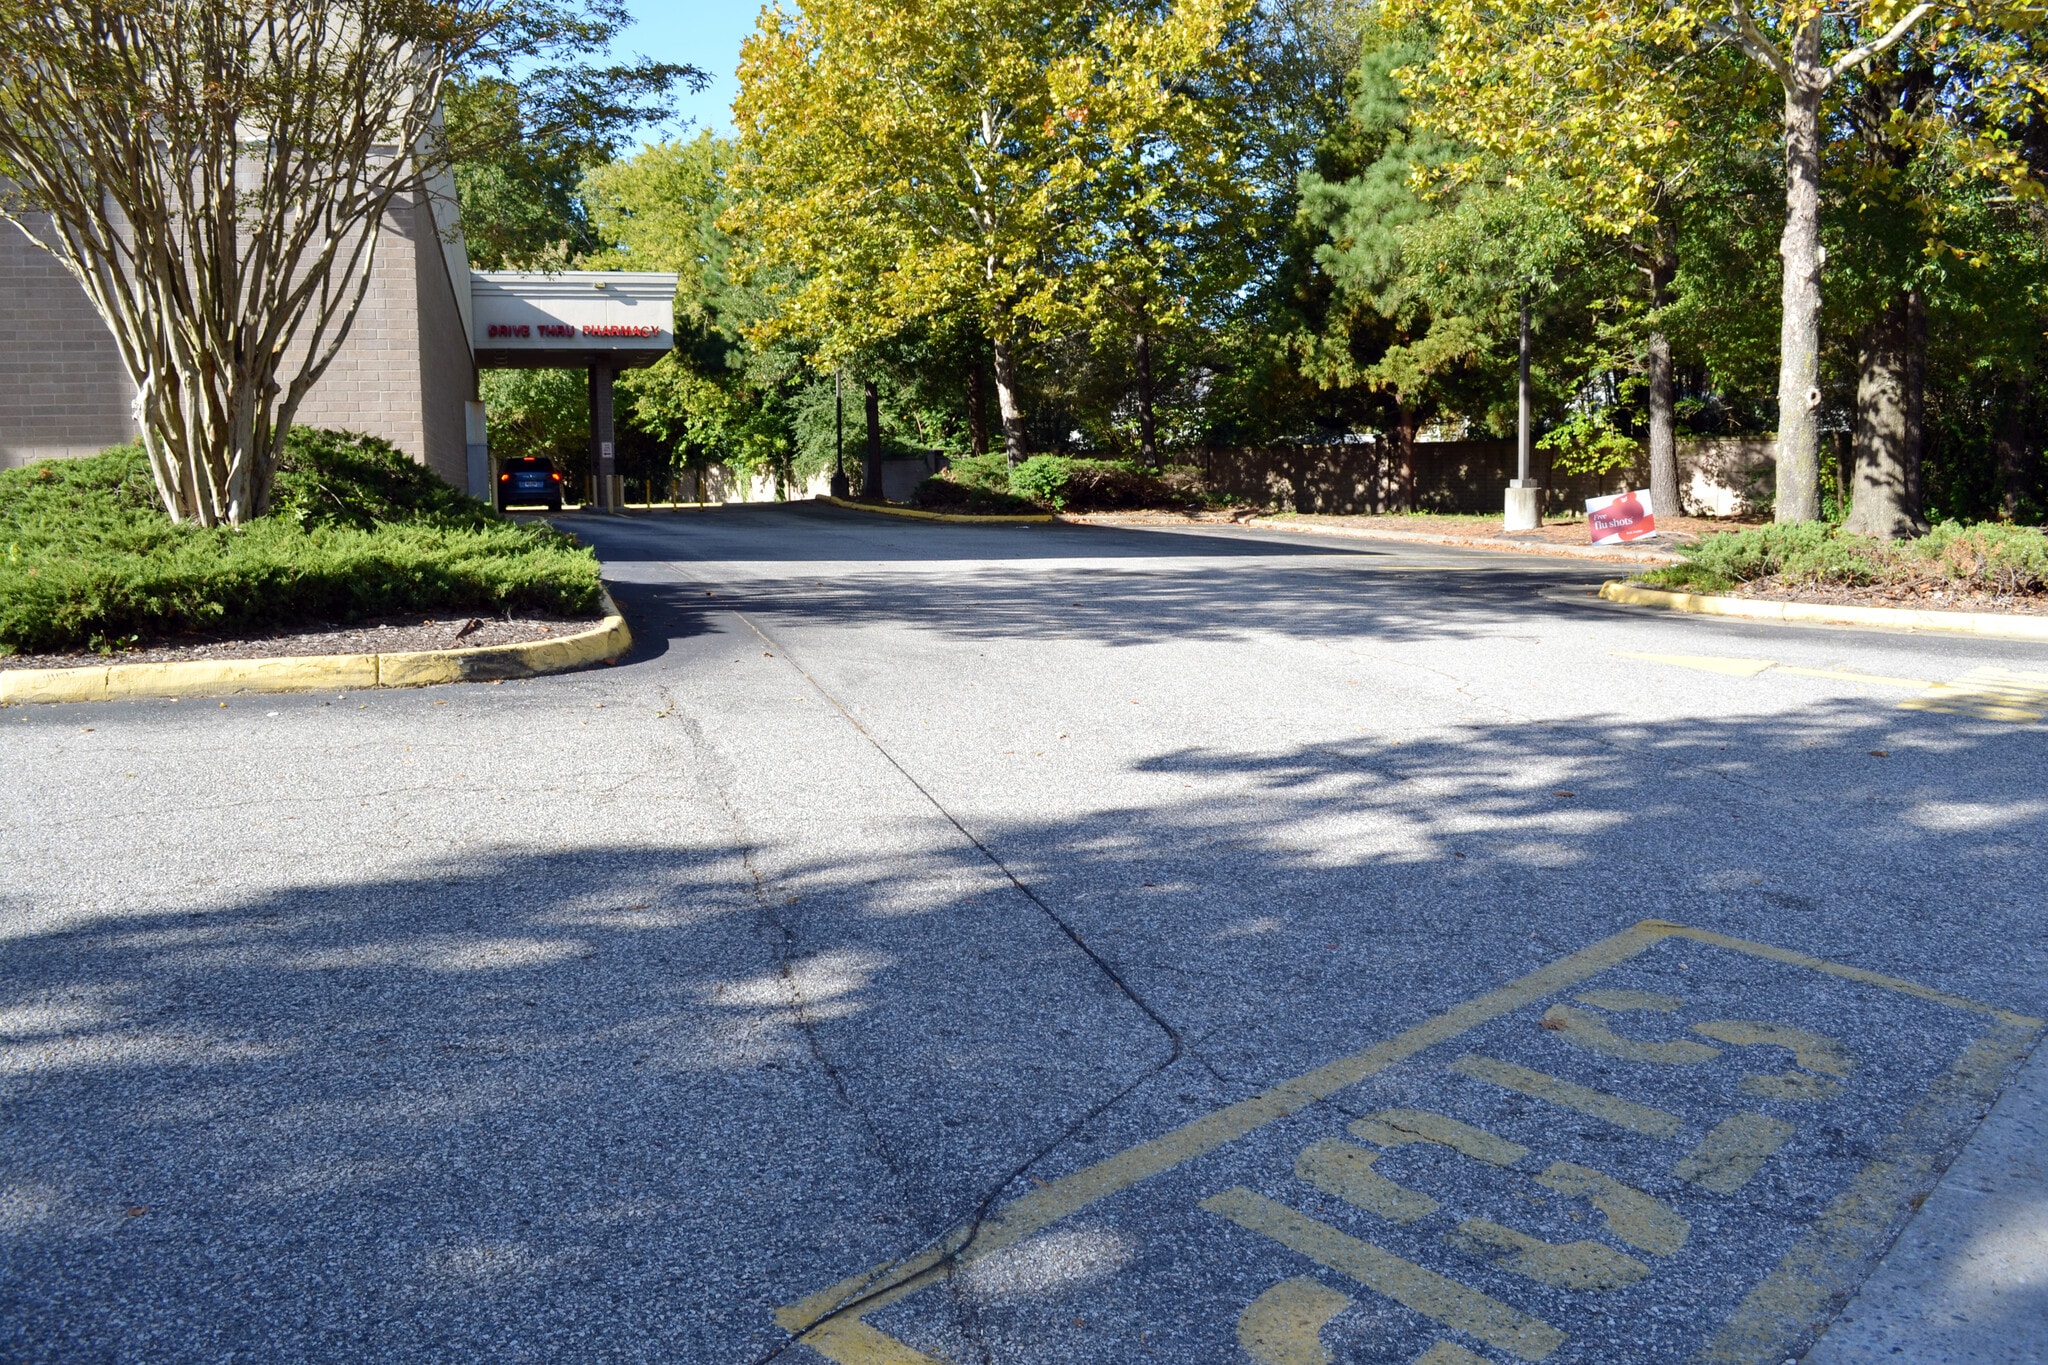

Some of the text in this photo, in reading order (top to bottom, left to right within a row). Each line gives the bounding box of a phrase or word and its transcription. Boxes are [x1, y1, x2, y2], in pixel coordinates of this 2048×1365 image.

[488, 324, 660, 339] DRIVE THRU PHARMACY
[1593, 513, 1607, 521] Free
[1594, 517, 1634, 531] flu shots
